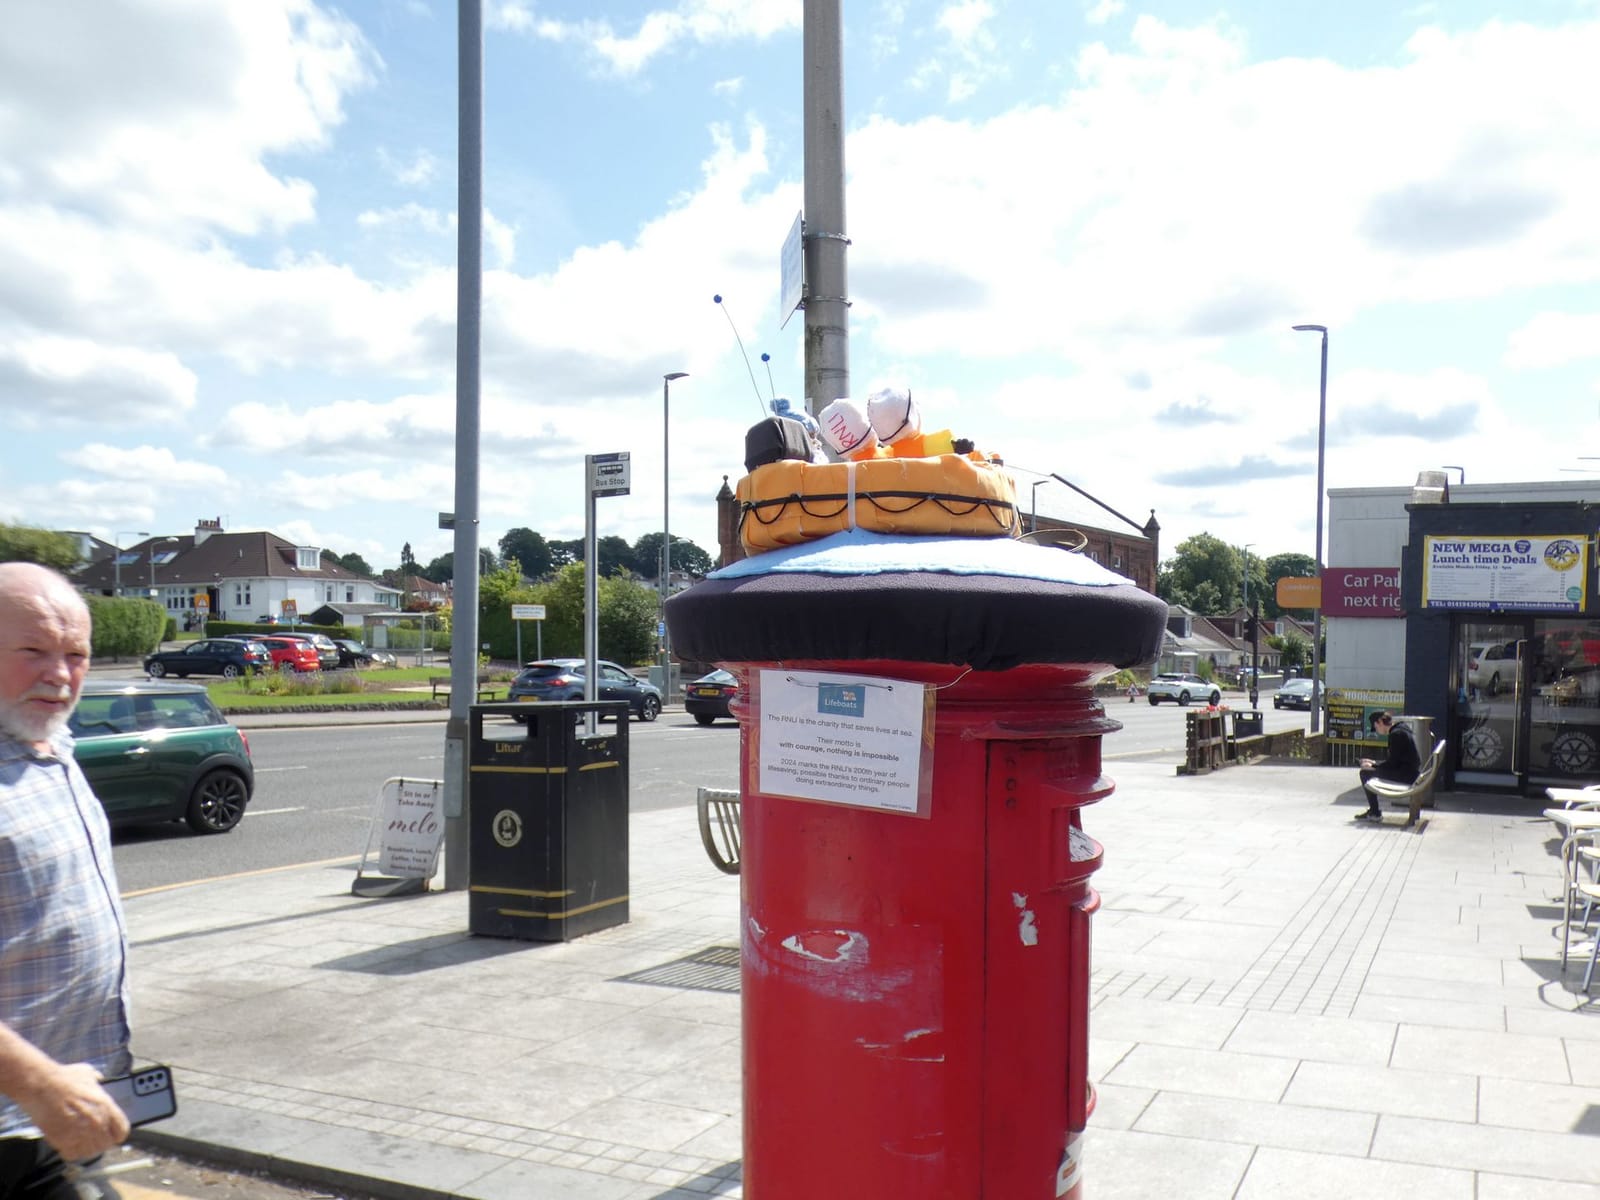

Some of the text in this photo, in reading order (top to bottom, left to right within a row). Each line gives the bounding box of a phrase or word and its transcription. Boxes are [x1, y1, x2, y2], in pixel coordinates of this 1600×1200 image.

[828, 412, 859, 448] RNLI
[1433, 543, 1465, 553] NEW
[1469, 543, 1512, 553] MEGA
[1432, 554, 1537, 564] Lunch time Deals
[1344, 574, 1369, 587] Car
[1344, 594, 1378, 607] next
[824, 698, 857, 709] Lifeboats
[768, 714, 780, 722] The
[781, 715, 797, 724] RNLI
[806, 718, 816, 726] the
[817, 719, 839, 729] charity
[876, 726, 890, 734] lives
[816, 736, 833, 745] Their
[835, 738, 854, 747] motto
[795, 743, 825, 753] courage,
[826, 747, 852, 757] nothing
[862, 750, 899, 762] impossible
[780, 758, 797, 766] 2024
[819, 762, 830, 770] the
[853, 767, 872, 775] 200th
[874, 770, 888, 778] year
[795, 776, 880, 793] doing extraordinary things.
[800, 768, 827, 778] possible
[828, 772, 850, 781] thanks
[859, 776, 885, 786] ordinary
[887, 780, 910, 789] people
[388, 811, 437, 834] melo
